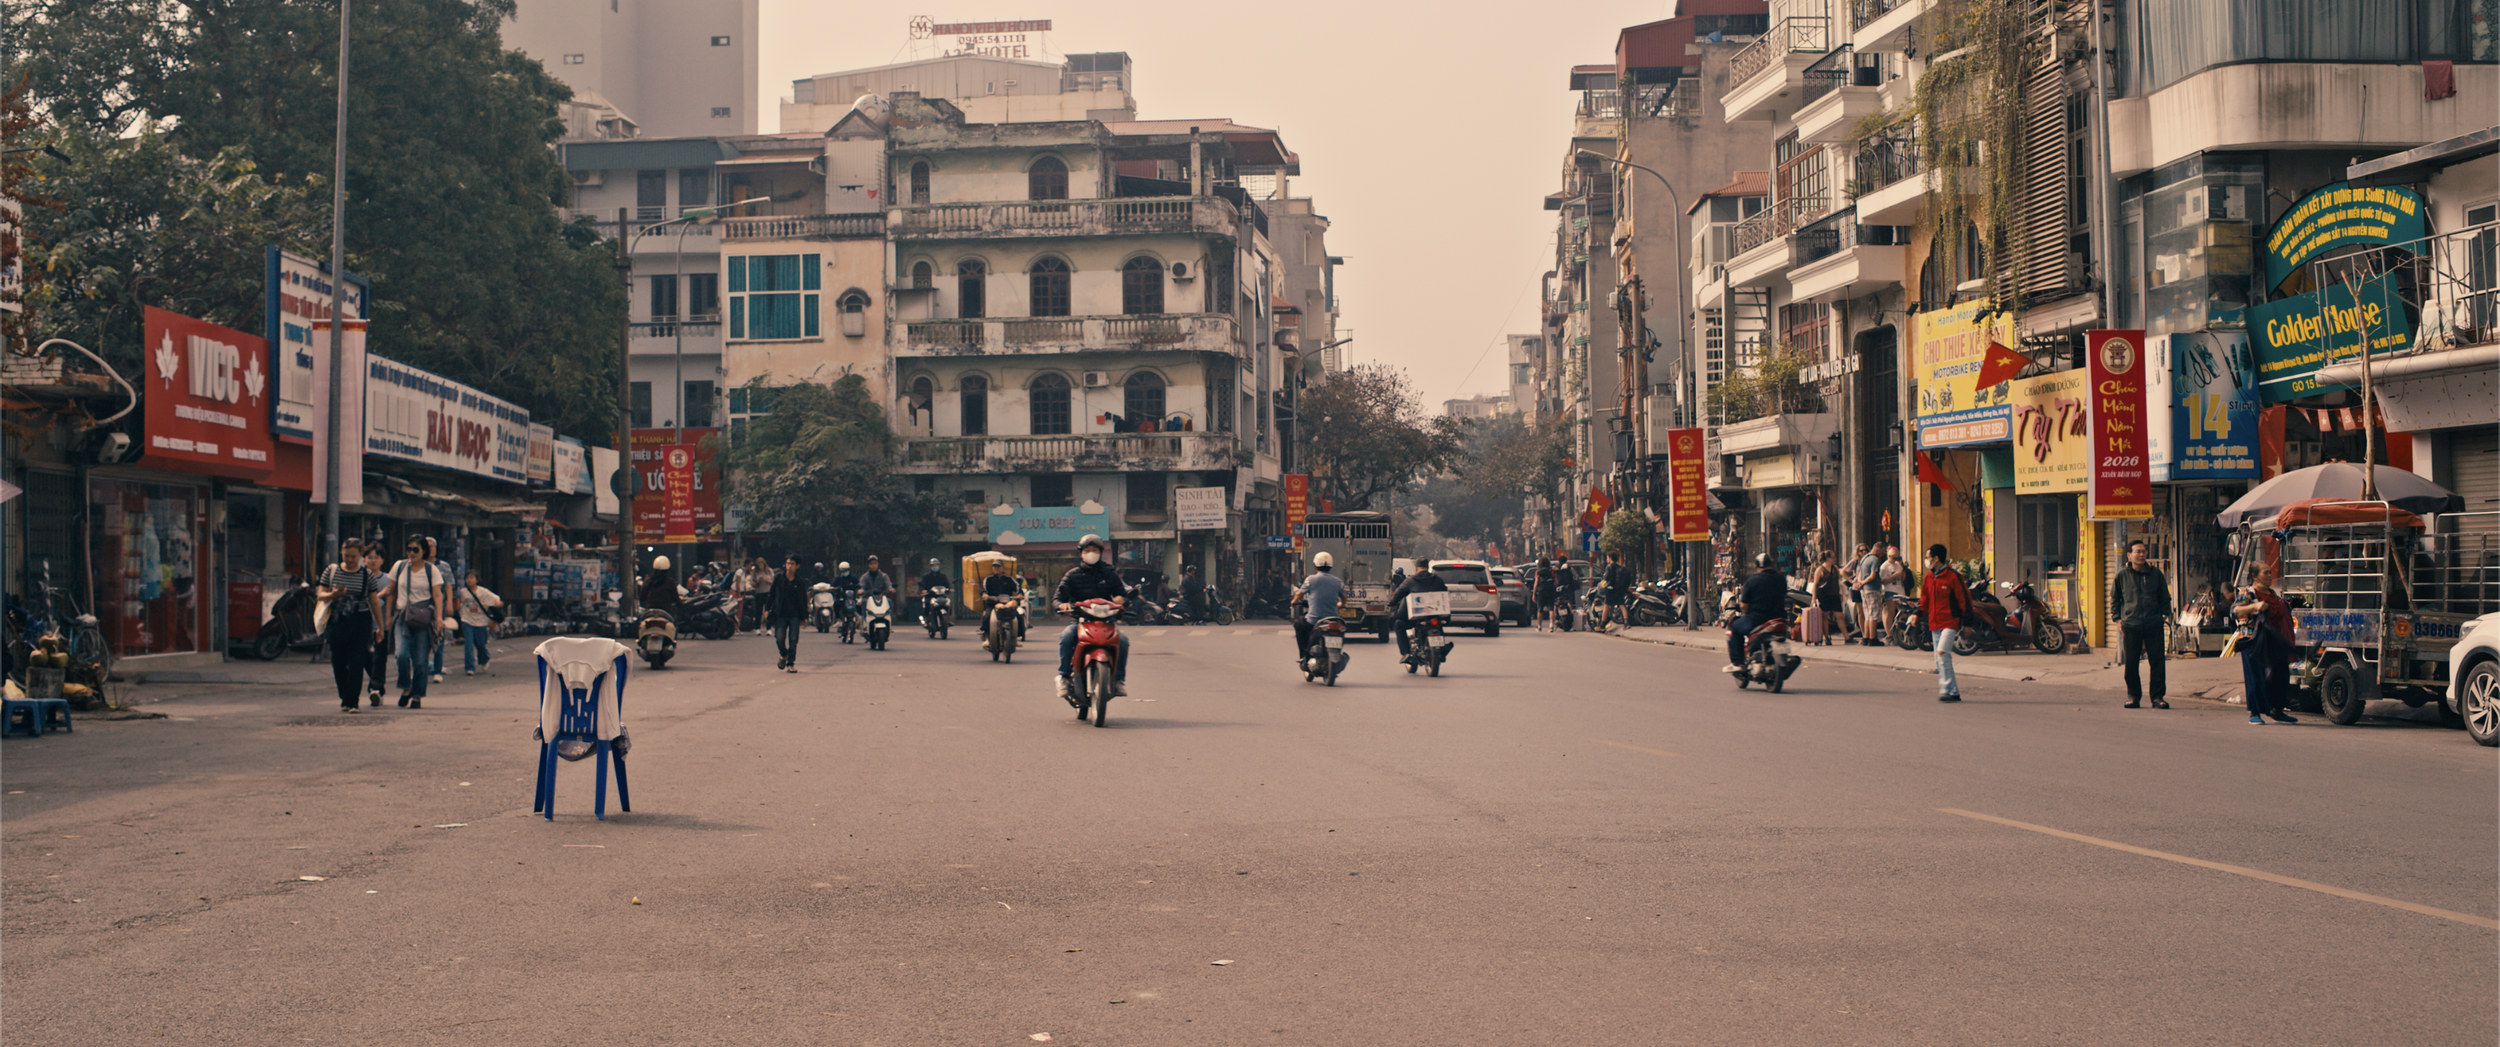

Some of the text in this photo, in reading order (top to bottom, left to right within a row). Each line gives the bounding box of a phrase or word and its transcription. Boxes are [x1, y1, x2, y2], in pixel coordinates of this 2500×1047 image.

[934, 20, 1051, 35] HANOI VIEW HOTEL
[2267, 302, 2382, 348] Golden House
[1923, 339, 1941, 366] CHO
[1943, 328, 1966, 361] THUÊ
[1968, 330, 1980, 358] XE
[188, 334, 240, 404] VICC
[1933, 363, 1968, 380] MOTORBIKE
[2099, 379, 2138, 395] Chúc
[2292, 380, 2304, 393] GO
[2306, 379, 2315, 390] 15
[2102, 398, 2136, 424] Mừng
[2182, 393, 2231, 440] 14
[2106, 418, 2134, 434] Năm
[426, 400, 454, 454] HẢI
[456, 416, 491, 470] NGỌC
[2109, 436, 2132, 454] Mới
[2102, 456, 2140, 467] 2026
[1179, 491, 1203, 500] SINH
